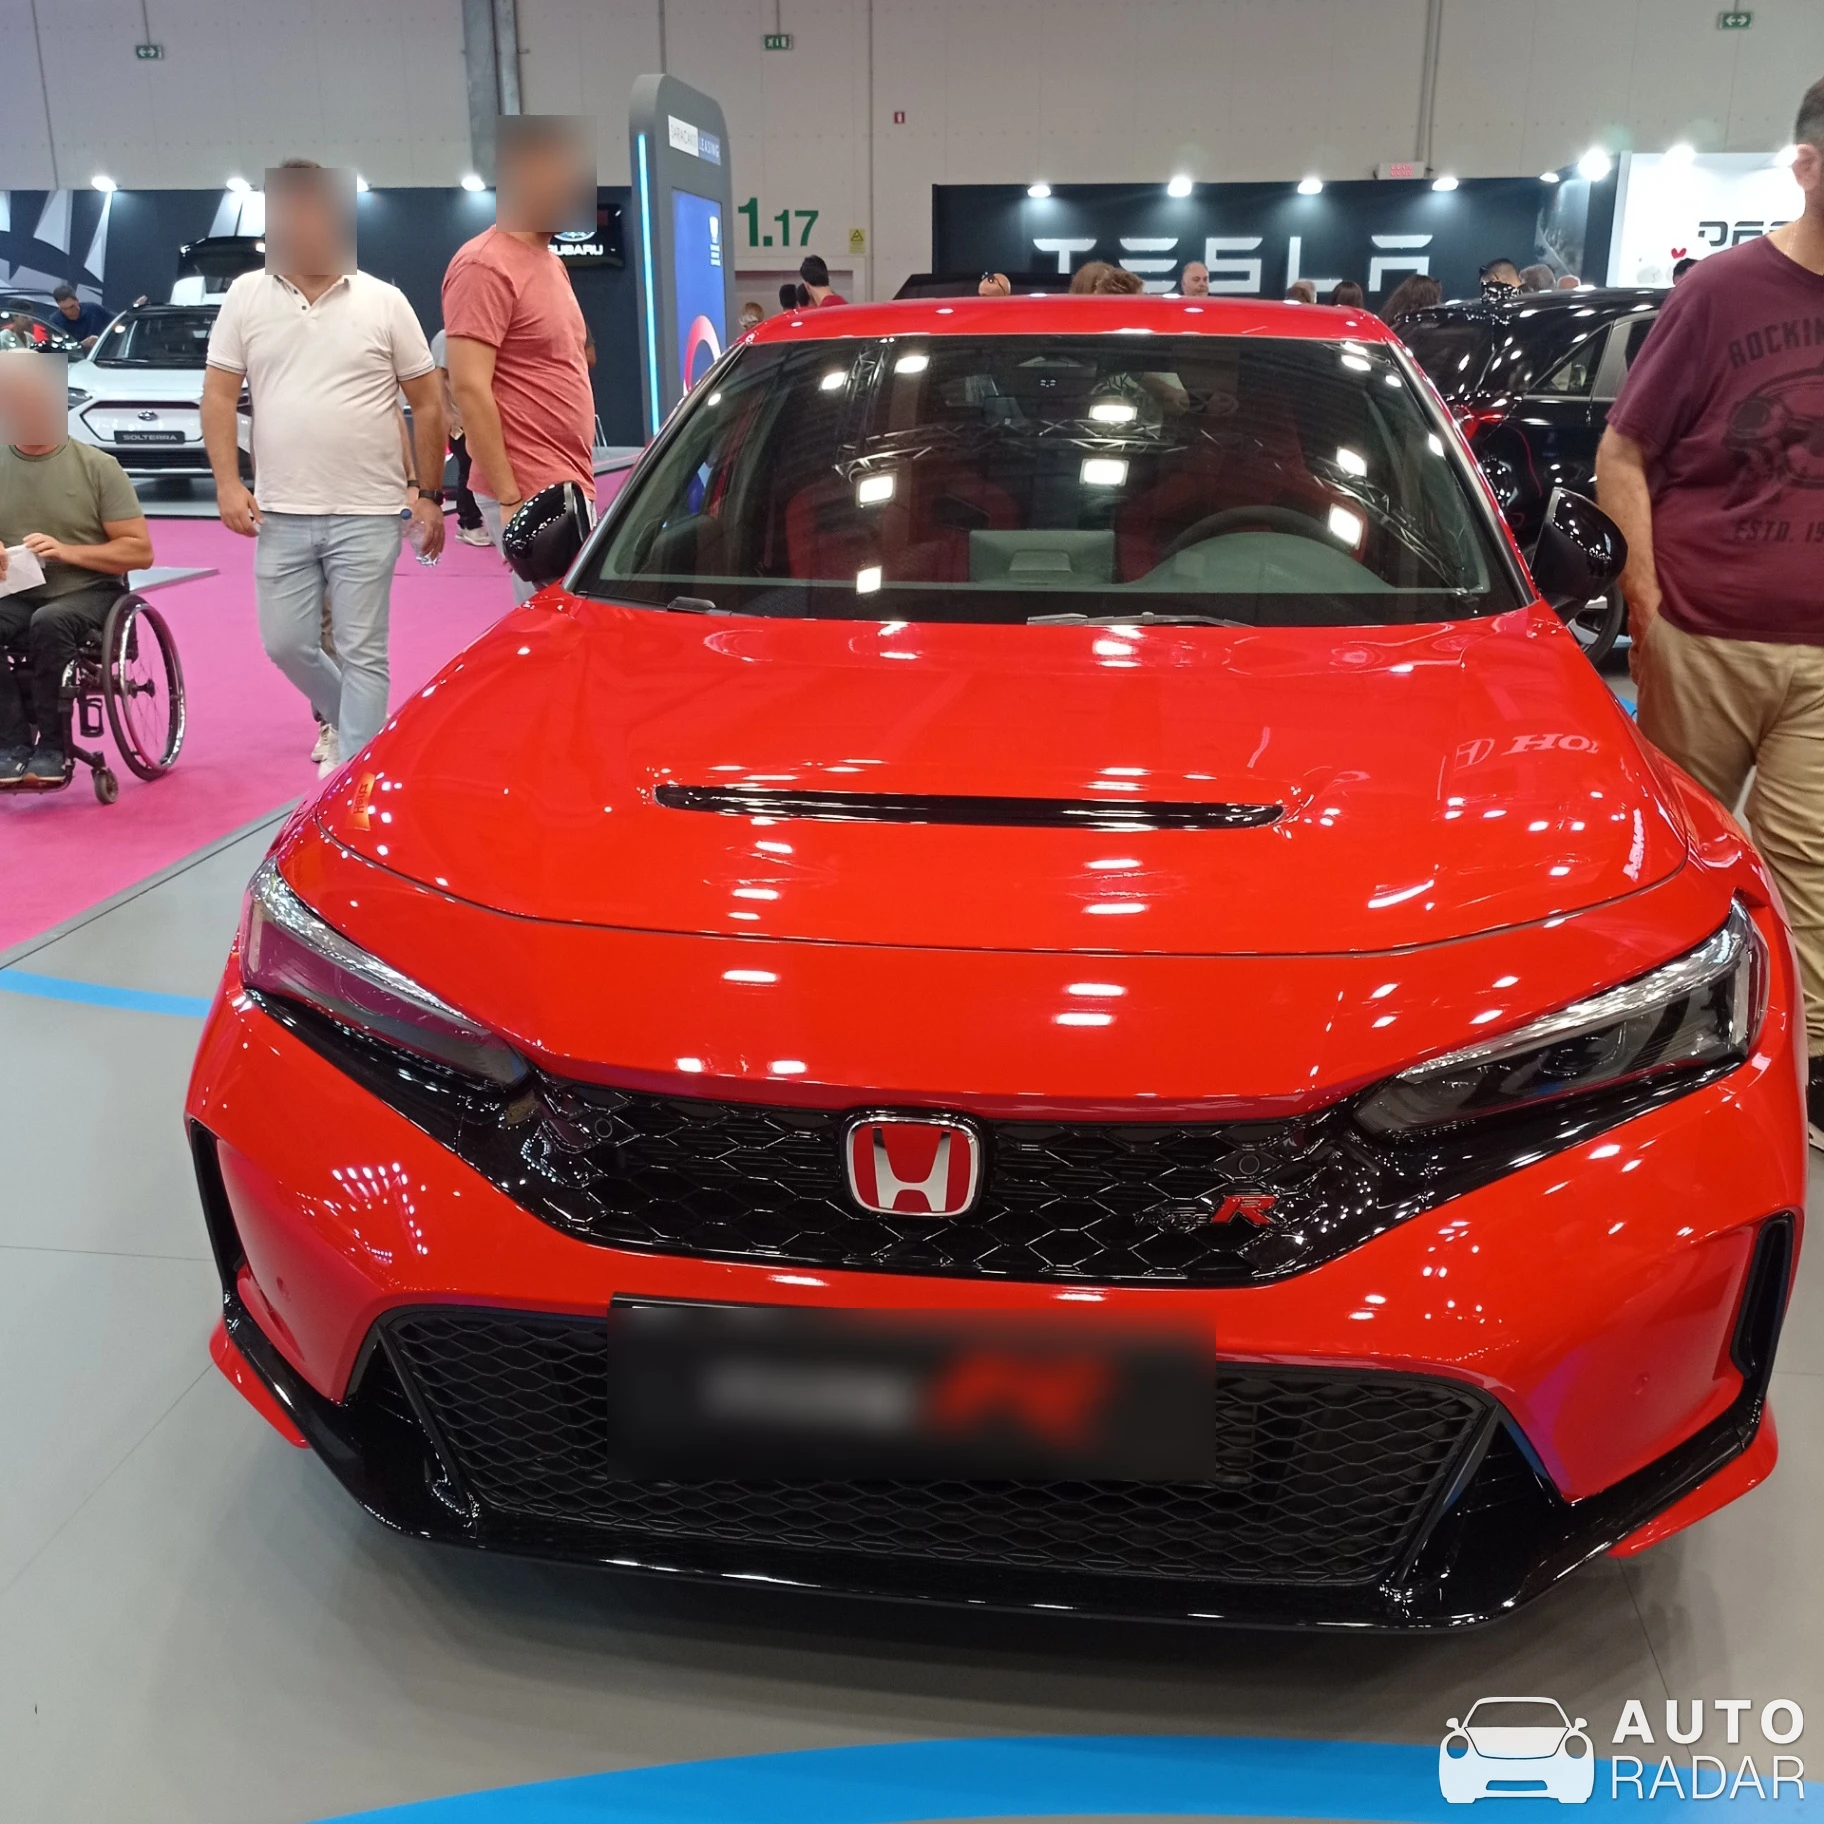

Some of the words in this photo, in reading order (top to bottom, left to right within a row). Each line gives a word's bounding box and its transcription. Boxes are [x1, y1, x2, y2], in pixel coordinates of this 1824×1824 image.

[738, 197, 819, 246] 1.17
[1033, 235, 1433, 293] TESLA
[1209, 1194, 1277, 1226] R
